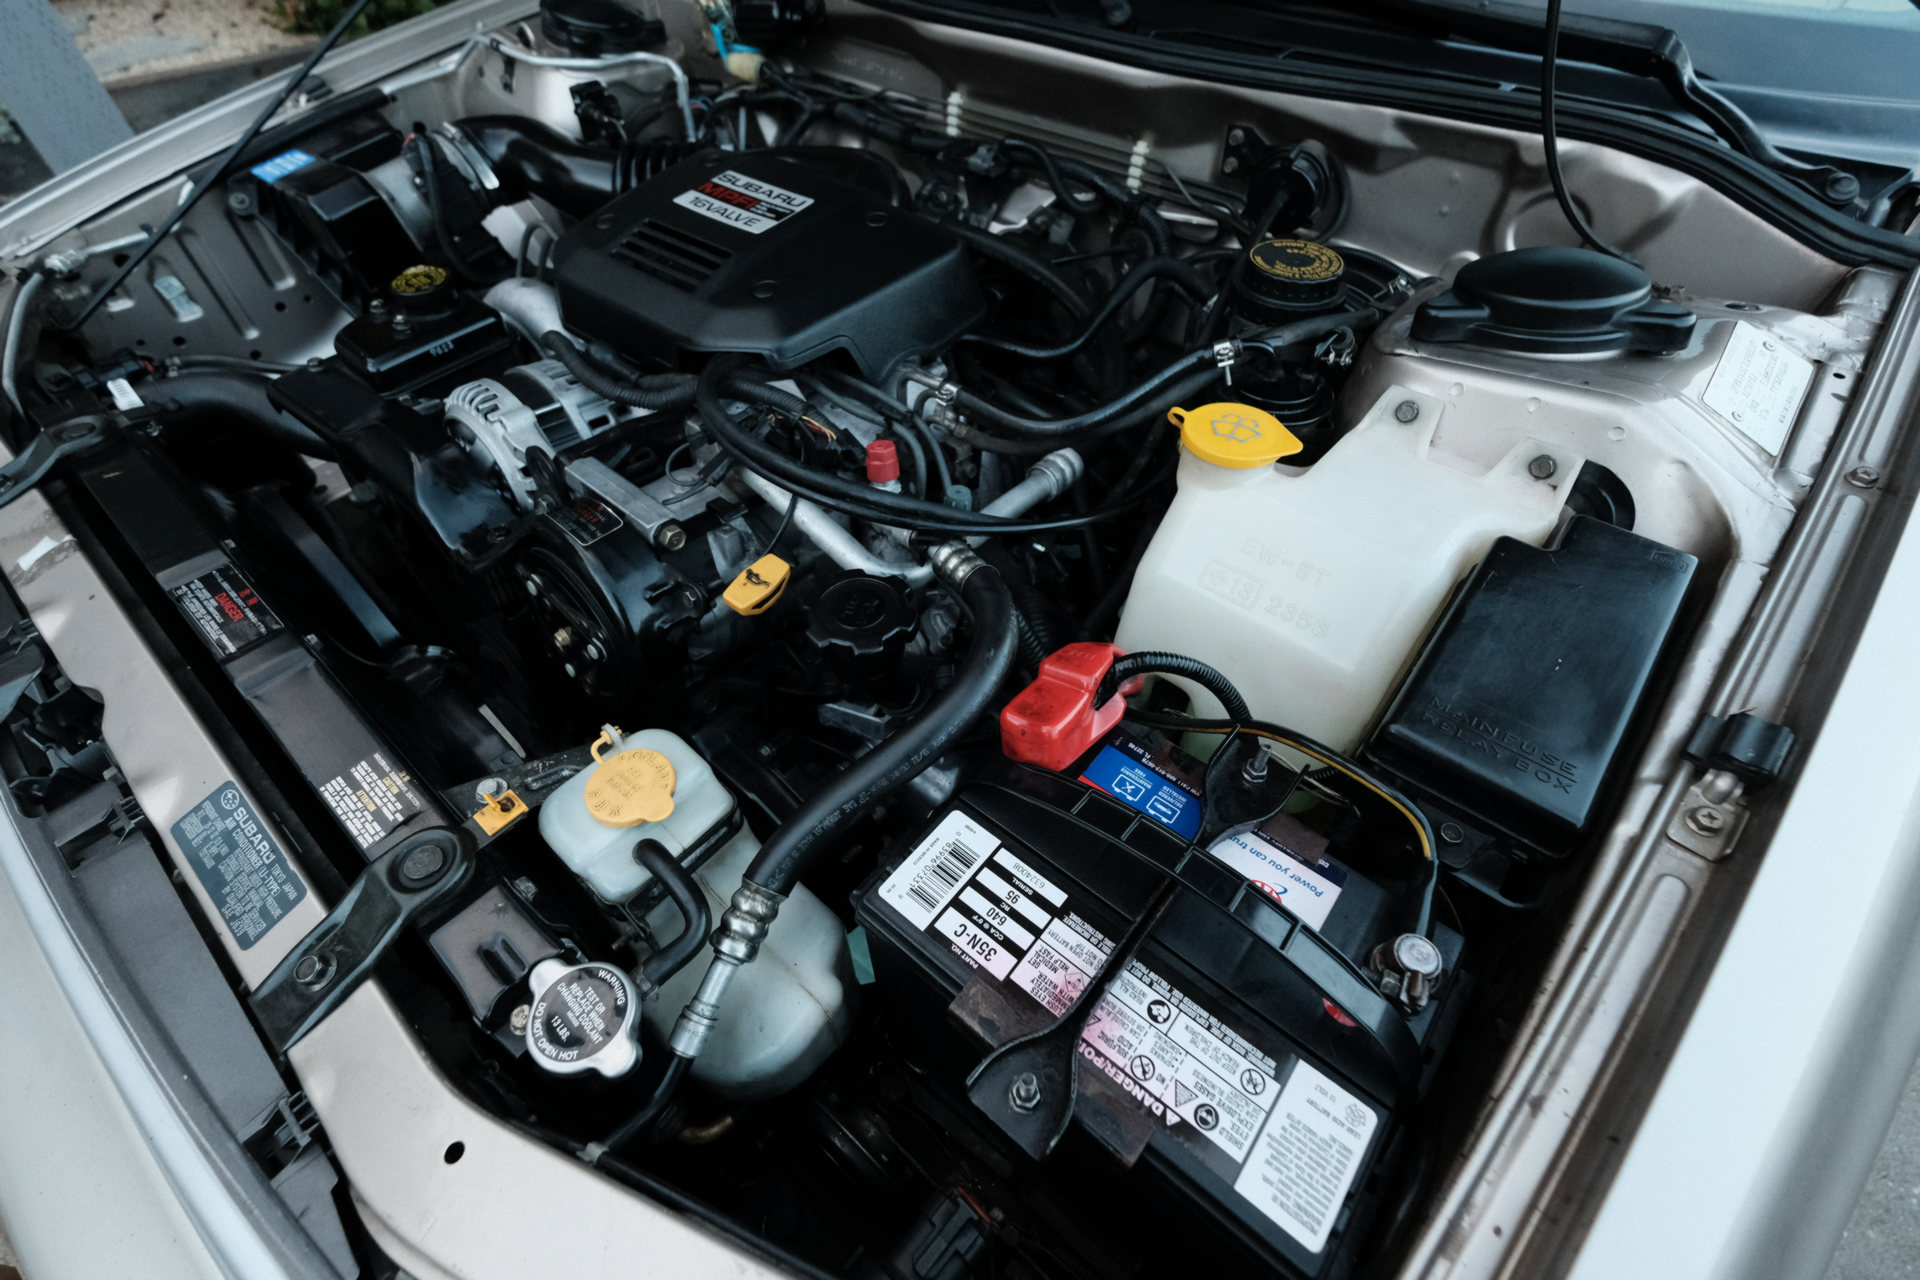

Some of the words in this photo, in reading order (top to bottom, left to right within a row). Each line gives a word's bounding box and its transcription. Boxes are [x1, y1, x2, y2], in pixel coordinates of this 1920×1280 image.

[715, 172, 808, 208] SUBARU
[685, 195, 762, 228] 16VALVE
[212, 591, 245, 622] DANGER
[1431, 696, 1499, 737] MAIN
[1502, 731, 1578, 776] FUSE
[1422, 710, 1501, 759] RELAY
[1512, 757, 1573, 794] BOX
[1118, 767, 1154, 788] MAINTENANCE
[1155, 790, 1185, 808] DELIVERED
[223, 815, 237, 831] AIR
[231, 827, 263, 870] CONDITIONER
[256, 864, 281, 898] (U-TYPE)
[232, 805, 276, 865] SUBARU
[269, 863, 286, 884] TOKYO
[281, 880, 298, 901] JAPAN
[928, 841, 954, 864] 83996
[1247, 846, 1268, 861] can
[907, 864, 933, 888] 07331
[1011, 860, 1046, 890] 6324008
[1266, 857, 1290, 875] you
[1010, 875, 1034, 896] SERIAL
[1288, 872, 1324, 898] Power
[999, 901, 1011, 911] RC
[1004, 889, 1021, 905] 95
[220, 902, 234, 920] SAE
[985, 906, 1008, 927] 640
[952, 921, 998, 963] 35N-C
[988, 926, 1004, 941] CCA
[948, 942, 962, 955] NO.
[1036, 943, 1055, 960] FAST.
[1067, 944, 1084, 958] OPEN
[1084, 948, 1098, 960] NOT
[960, 952, 979, 969] PART
[1026, 955, 1041, 969] GET
[1031, 950, 1059, 974] MEDICAL
[1052, 956, 1070, 972] HELP
[1081, 955, 1095, 967] NOT
[598, 968, 626, 1005] WARNING
[1034, 970, 1059, 991] WATER.
[1118, 982, 1129, 994] ALL
[585, 985, 599, 1005] TEST
[595, 1001, 605, 1015] OR
[1029, 985, 1047, 1002] EYES
[1056, 987, 1075, 1004] WITH
[1128, 990, 1144, 1006] READ
[535, 1002, 547, 1017] DO
[557, 981, 582, 1016] CHANGING
[578, 1013, 603, 1045] COOLANT
[569, 981, 592, 1013] REPLACE
[588, 1009, 605, 1031] WHEN
[533, 1018, 544, 1038] NOT
[550, 1014, 562, 1027] 13
[555, 1023, 571, 1042] LBS.
[1116, 1033, 1133, 1050] ACID
[537, 1036, 559, 1058] OPEN
[1096, 1029, 1129, 1060] SULFURIC
[559, 1050, 579, 1060] HOT
[1072, 1038, 1166, 1116] DANGER/POI
[1221, 1060, 1236, 1075] KEEP
[1155, 1072, 1166, 1085] NO
[1192, 1079, 1216, 1102] GASES
[1216, 1097, 1254, 1132] EXPLOSIVE
[1218, 1125, 1244, 1151] SHIELD
